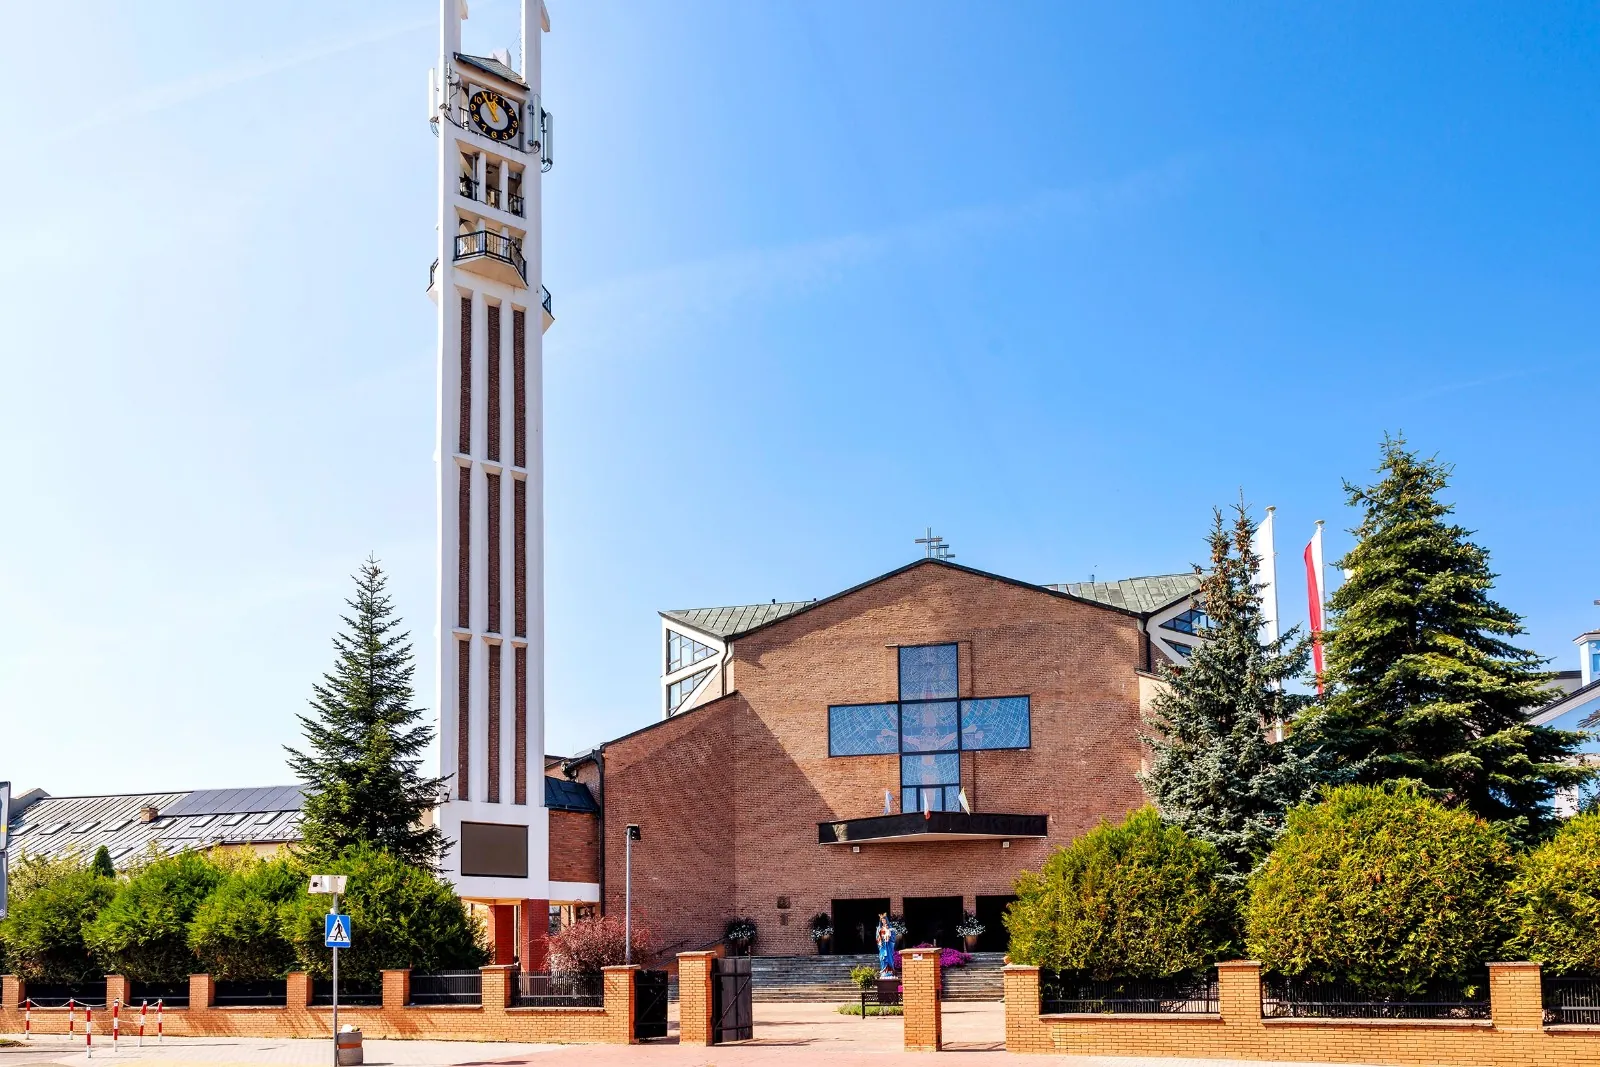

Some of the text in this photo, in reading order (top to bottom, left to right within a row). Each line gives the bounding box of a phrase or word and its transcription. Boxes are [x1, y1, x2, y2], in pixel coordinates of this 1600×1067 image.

[474, 96, 482, 104] 10
[490, 92, 498, 102] 12
[470, 104, 476, 112] 9
[508, 108, 514, 116] 2
[473, 114, 480, 122] 8
[482, 124, 488, 132] 7
[512, 120, 518, 128] 3
[491, 130, 498, 138] 6
[508, 128, 514, 136] 4
